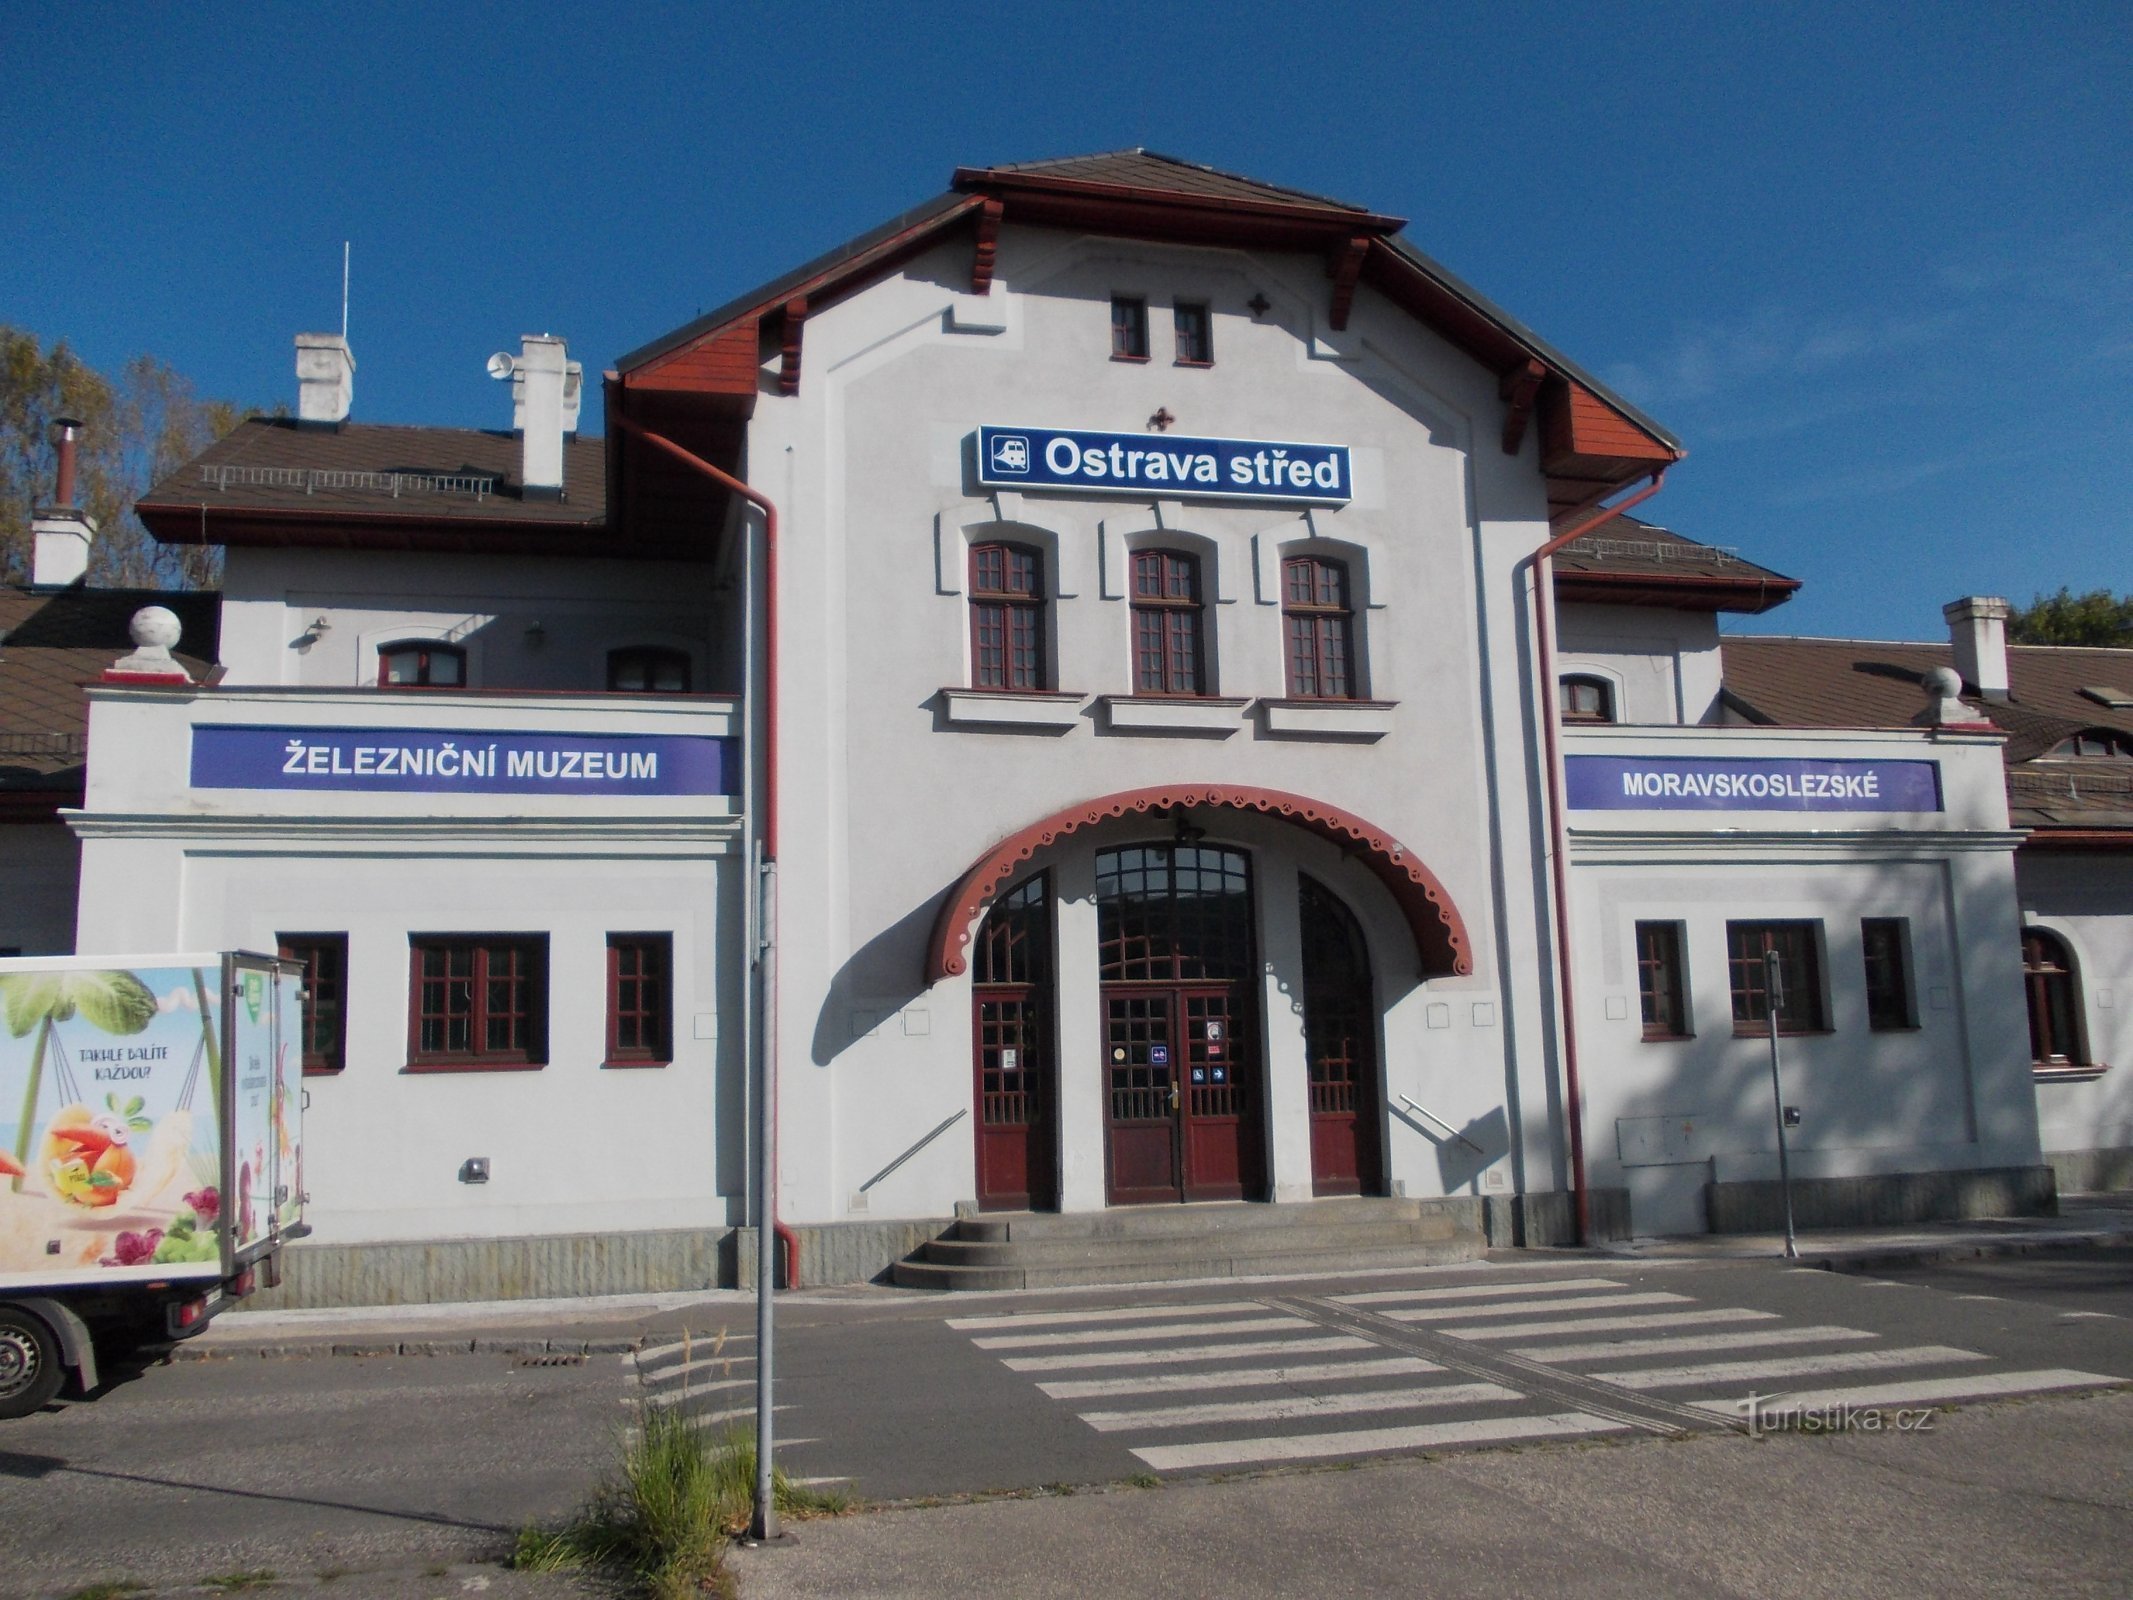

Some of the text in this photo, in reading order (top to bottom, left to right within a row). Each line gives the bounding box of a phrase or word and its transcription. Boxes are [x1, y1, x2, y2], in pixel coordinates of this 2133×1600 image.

[1045, 437, 1340, 489] Ostrava střed
[282, 739, 658, 780] ŽELEZNIČNÍ MUZEUM
[1622, 770, 1880, 799] MORAVSKOSLEZSKÉ
[79, 1048, 123, 1062] TAKHLE
[95, 1063, 152, 1081] KAŽDOU?
